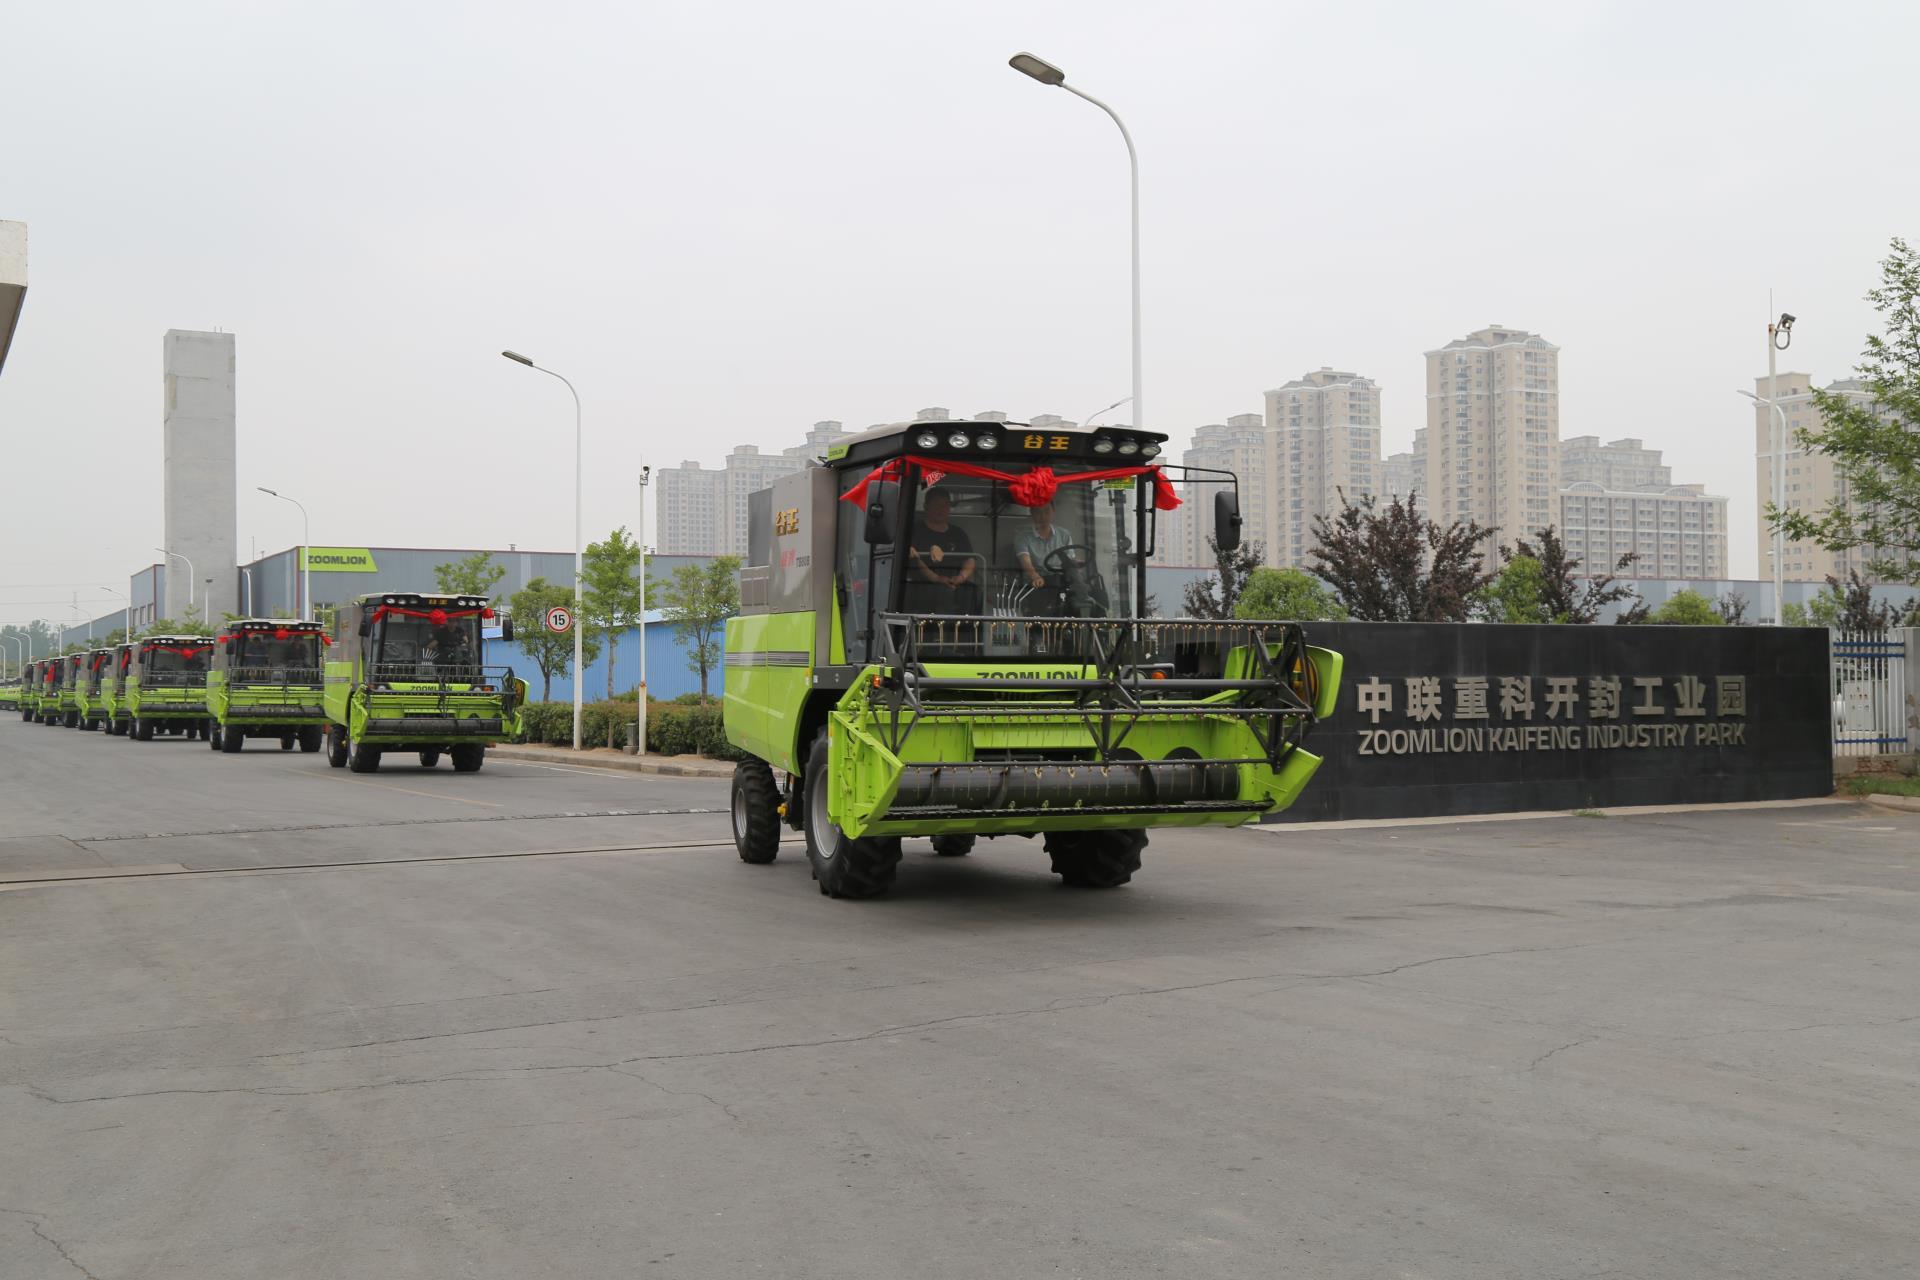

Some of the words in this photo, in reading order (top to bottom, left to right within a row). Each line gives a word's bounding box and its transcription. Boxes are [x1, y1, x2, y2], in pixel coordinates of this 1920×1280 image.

[1024, 435, 1070, 450] 谷王
[775, 508, 800, 537] 谷王
[308, 555, 367, 565] ZOOMLION
[552, 614, 566, 626] 15
[1357, 675, 1747, 723] 中联重科开封工业园
[1357, 728, 1483, 755] ZOOMLION
[1488, 725, 1581, 751] KAIFENG
[1587, 724, 1689, 749] INDUSTRY
[1694, 722, 1746, 746] PARK
